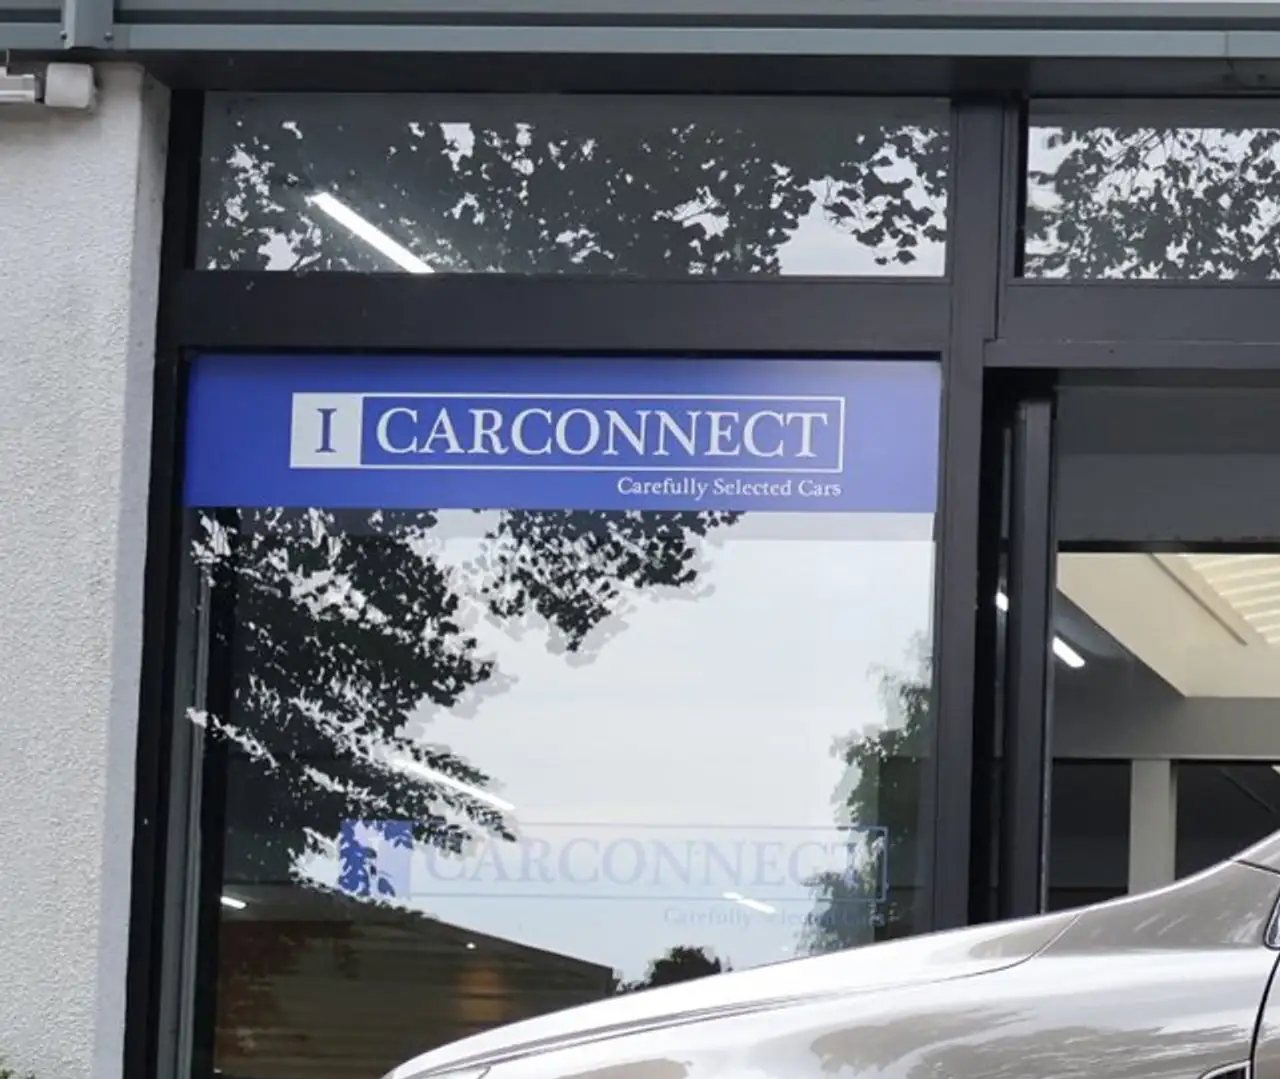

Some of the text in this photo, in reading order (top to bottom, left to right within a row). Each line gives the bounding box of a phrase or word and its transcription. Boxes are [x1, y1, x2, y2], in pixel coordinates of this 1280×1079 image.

[376, 406, 829, 459] CARCONNECT
[616, 476, 842, 501] Carefully Selected Cars
